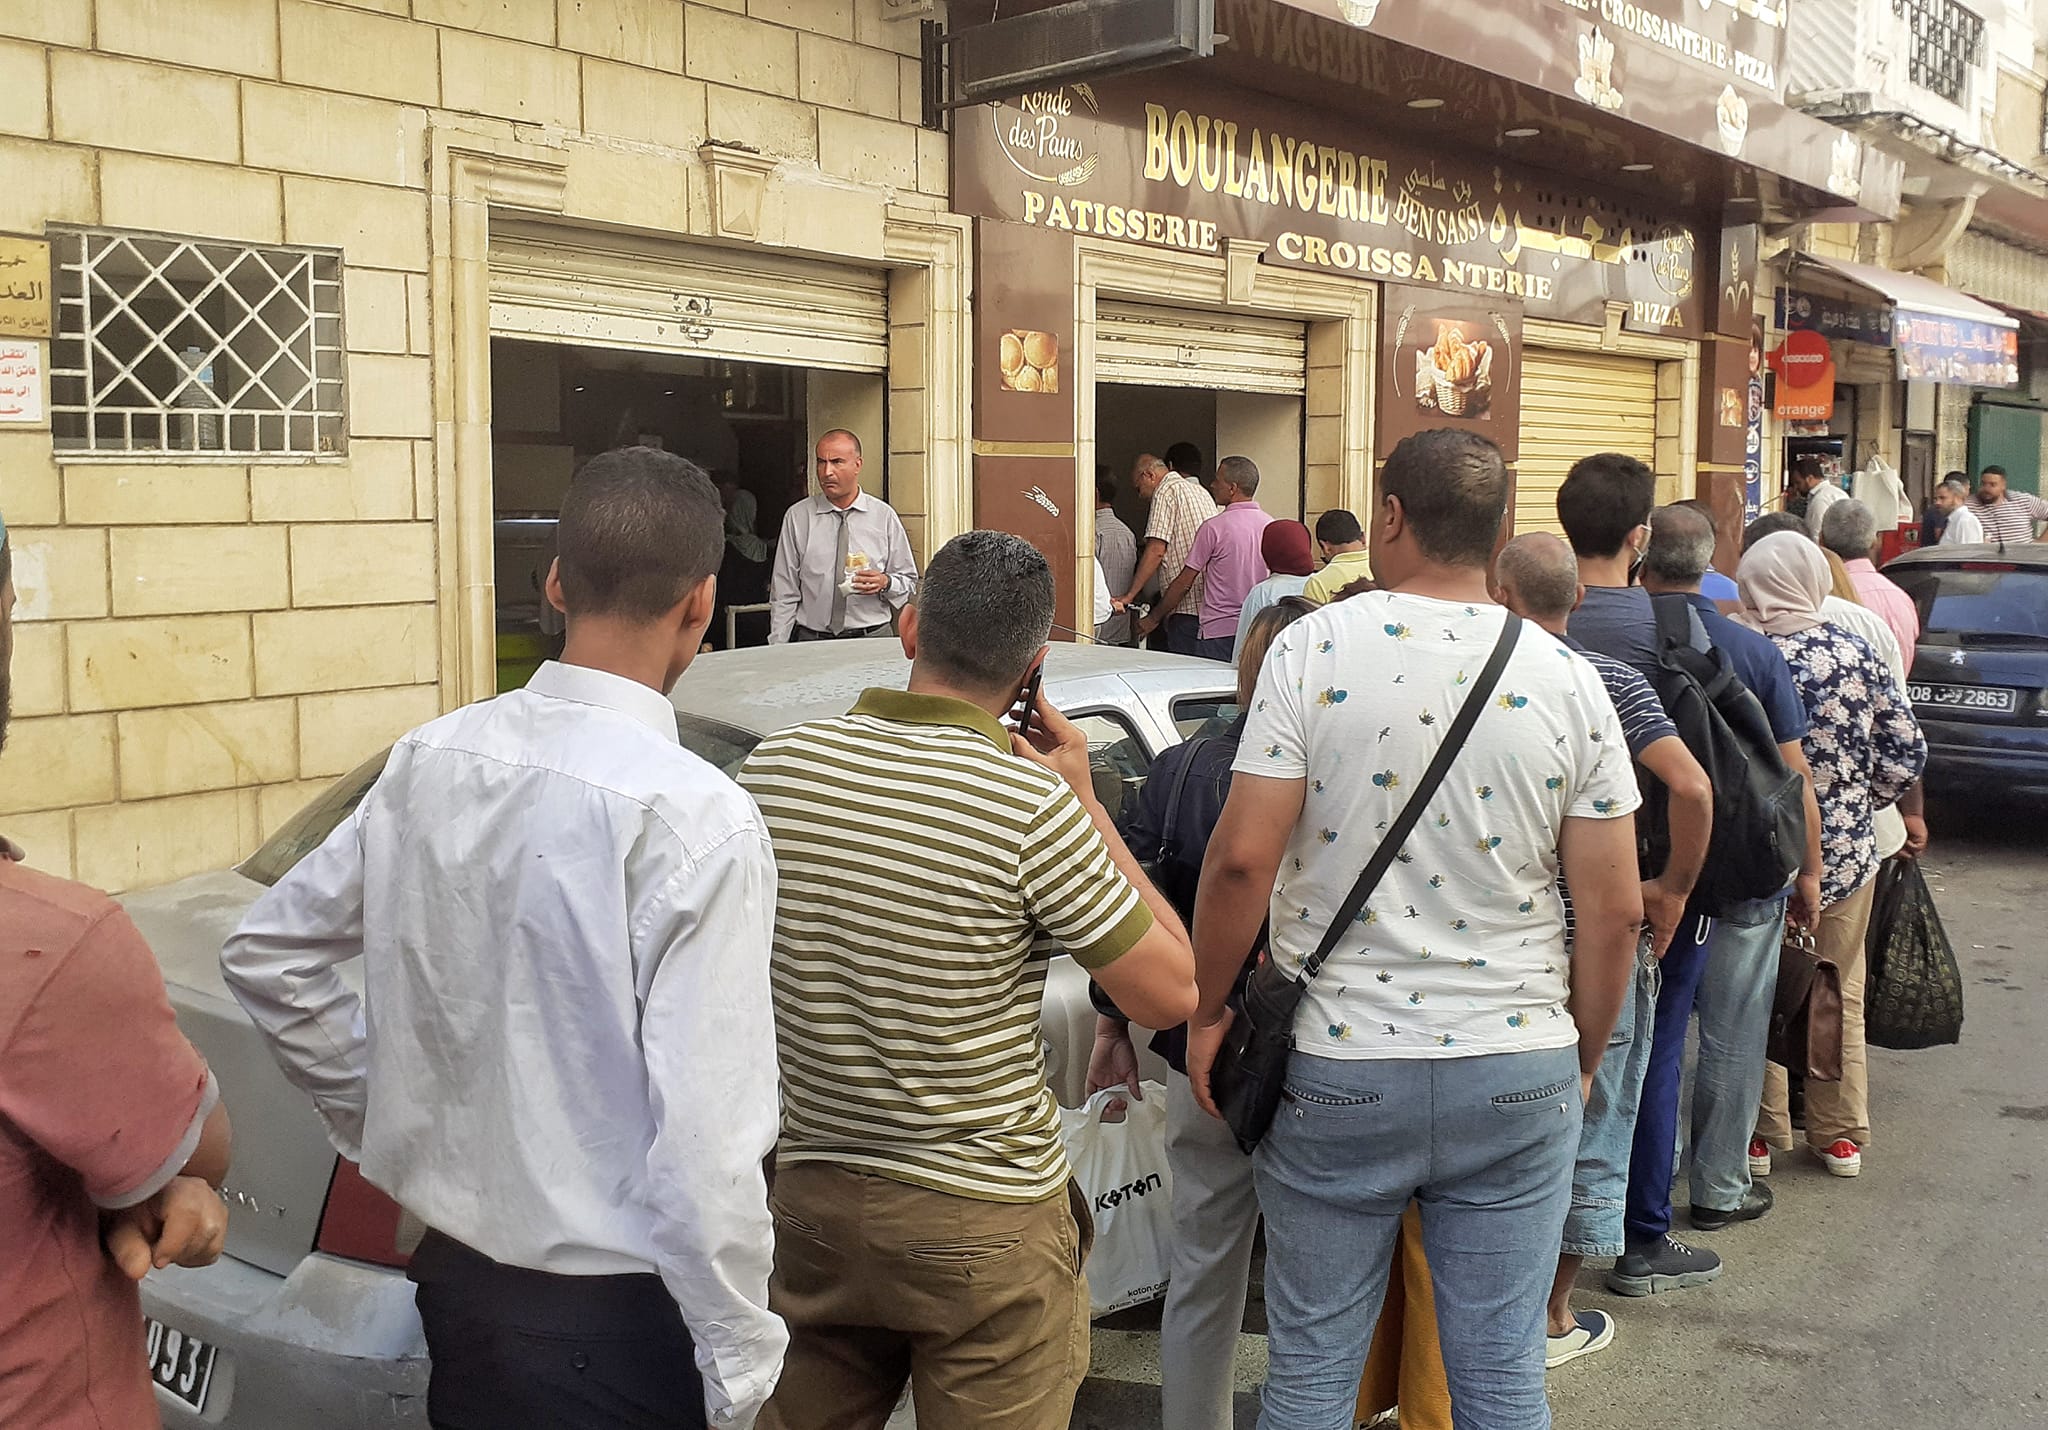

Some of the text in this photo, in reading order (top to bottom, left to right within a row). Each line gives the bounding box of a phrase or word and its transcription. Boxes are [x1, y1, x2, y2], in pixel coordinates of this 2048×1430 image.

[1600, 0, 1727, 69] CROISSANTERIE
[1733, 49, 1776, 91] PIZZA
[1008, 114, 1084, 161] des Pains
[1143, 101, 1389, 227] BOULANGERIE
[1022, 190, 1219, 252] PATISSERIE
[1393, 186, 1486, 246] BEN SASSI
[1633, 301, 1684, 327] PIZZA
[1777, 404, 1826, 418] orange
[1963, 690, 2009, 708] 2863
